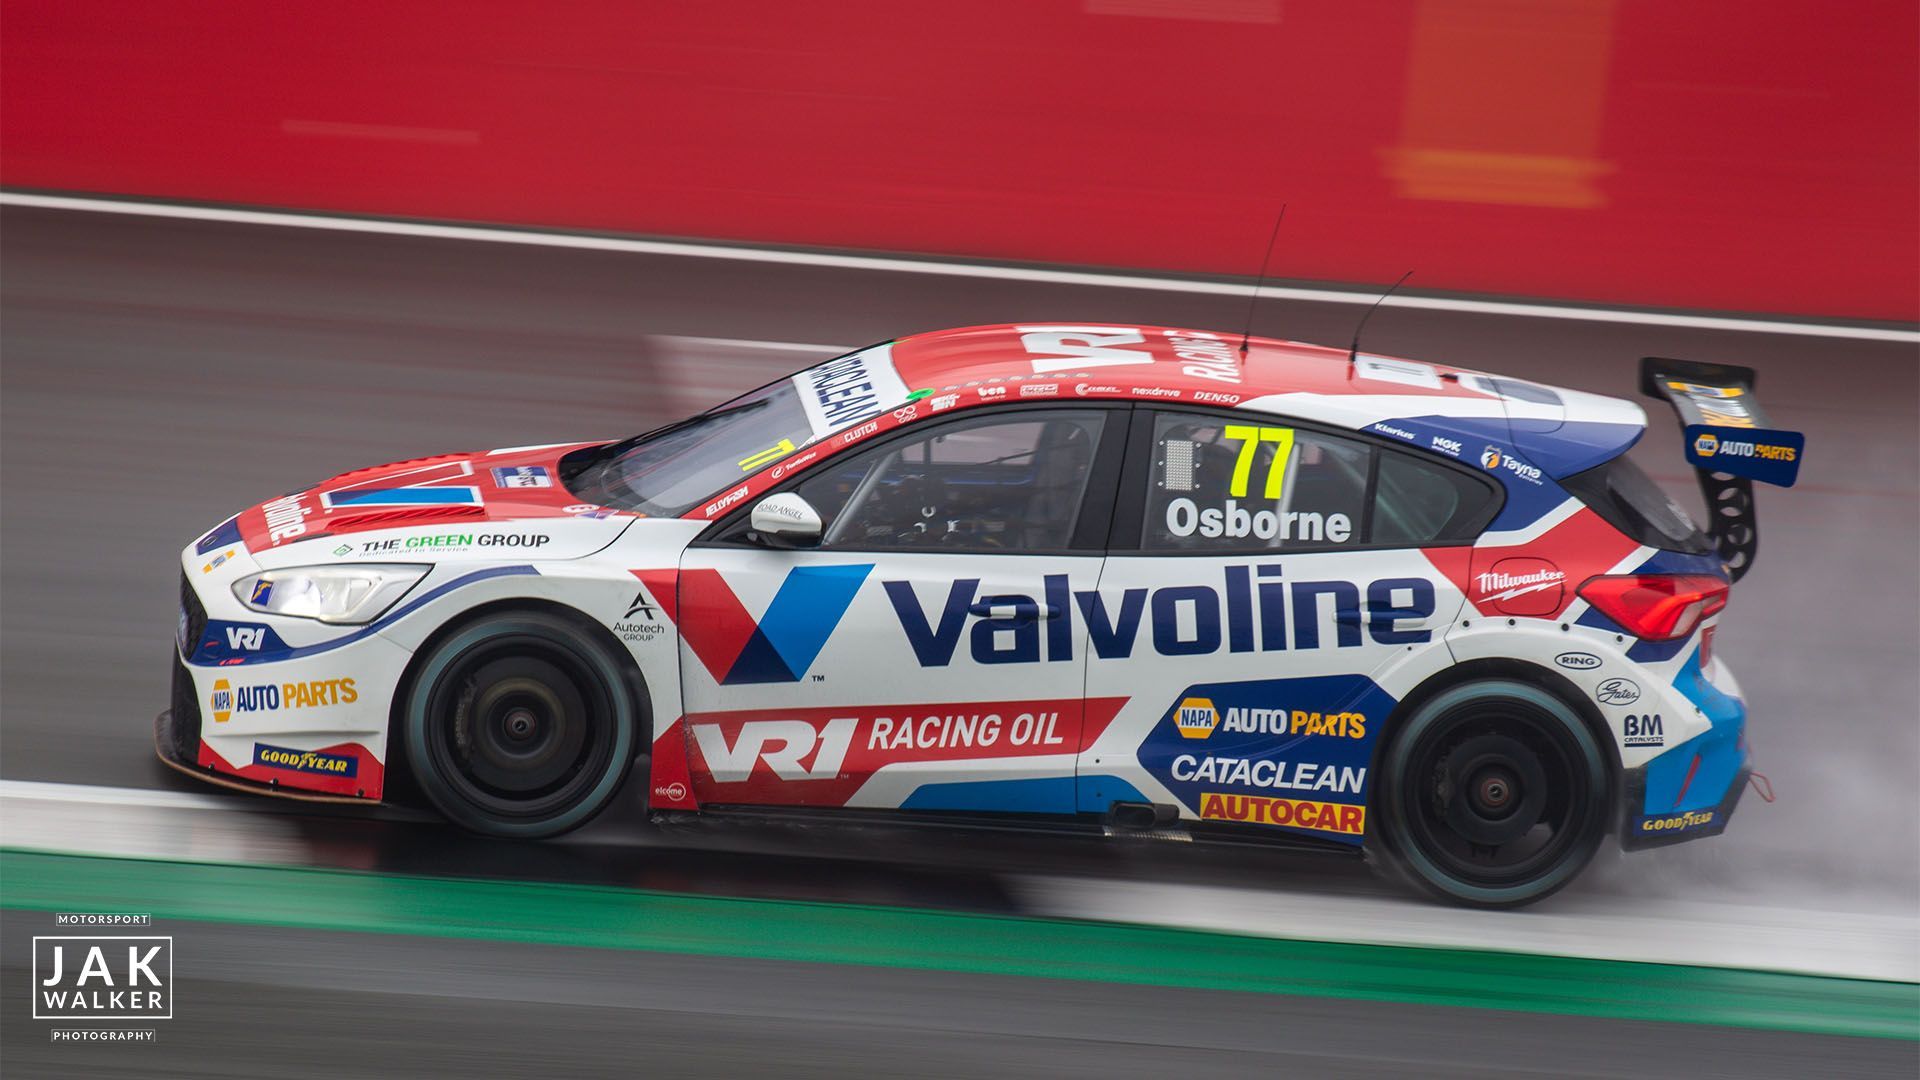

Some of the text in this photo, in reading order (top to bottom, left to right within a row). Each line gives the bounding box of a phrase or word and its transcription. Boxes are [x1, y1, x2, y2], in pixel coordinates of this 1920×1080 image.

[1193, 390, 1240, 404] DENSO
[843, 421, 879, 443] CLUTCH
[1374, 423, 1416, 440] Klarius
[1432, 436, 1462, 453] NGK
[1719, 440, 1796, 462] AUTO PARTS
[1225, 424, 1295, 500] 77
[1502, 454, 1543, 479] Tayna
[1166, 498, 1351, 543] Osborne
[362, 533, 550, 552] THE GREEN GROUP
[1474, 569, 1567, 594] Milwaukee
[881, 563, 1436, 668] Valvoline
[226, 626, 267, 651] VR1
[613, 622, 665, 634] Autotech
[623, 633, 655, 641] GROUP
[1561, 656, 1596, 666] RING
[213, 677, 359, 712] NAPA AUTO PARTS
[1598, 681, 1640, 703] Gates
[1181, 707, 1367, 740] NAPA AUTO PARTS
[1623, 714, 1664, 737] BM
[691, 712, 1064, 784] VR1 RACING OIL
[1623, 736, 1665, 744] CATALYSTS
[260, 749, 348, 773] GOODYEAR
[1171, 754, 1367, 794] CATACLEAN
[1202, 794, 1363, 834] AUTOCAR
[1642, 811, 1713, 831] GOODYEAR
